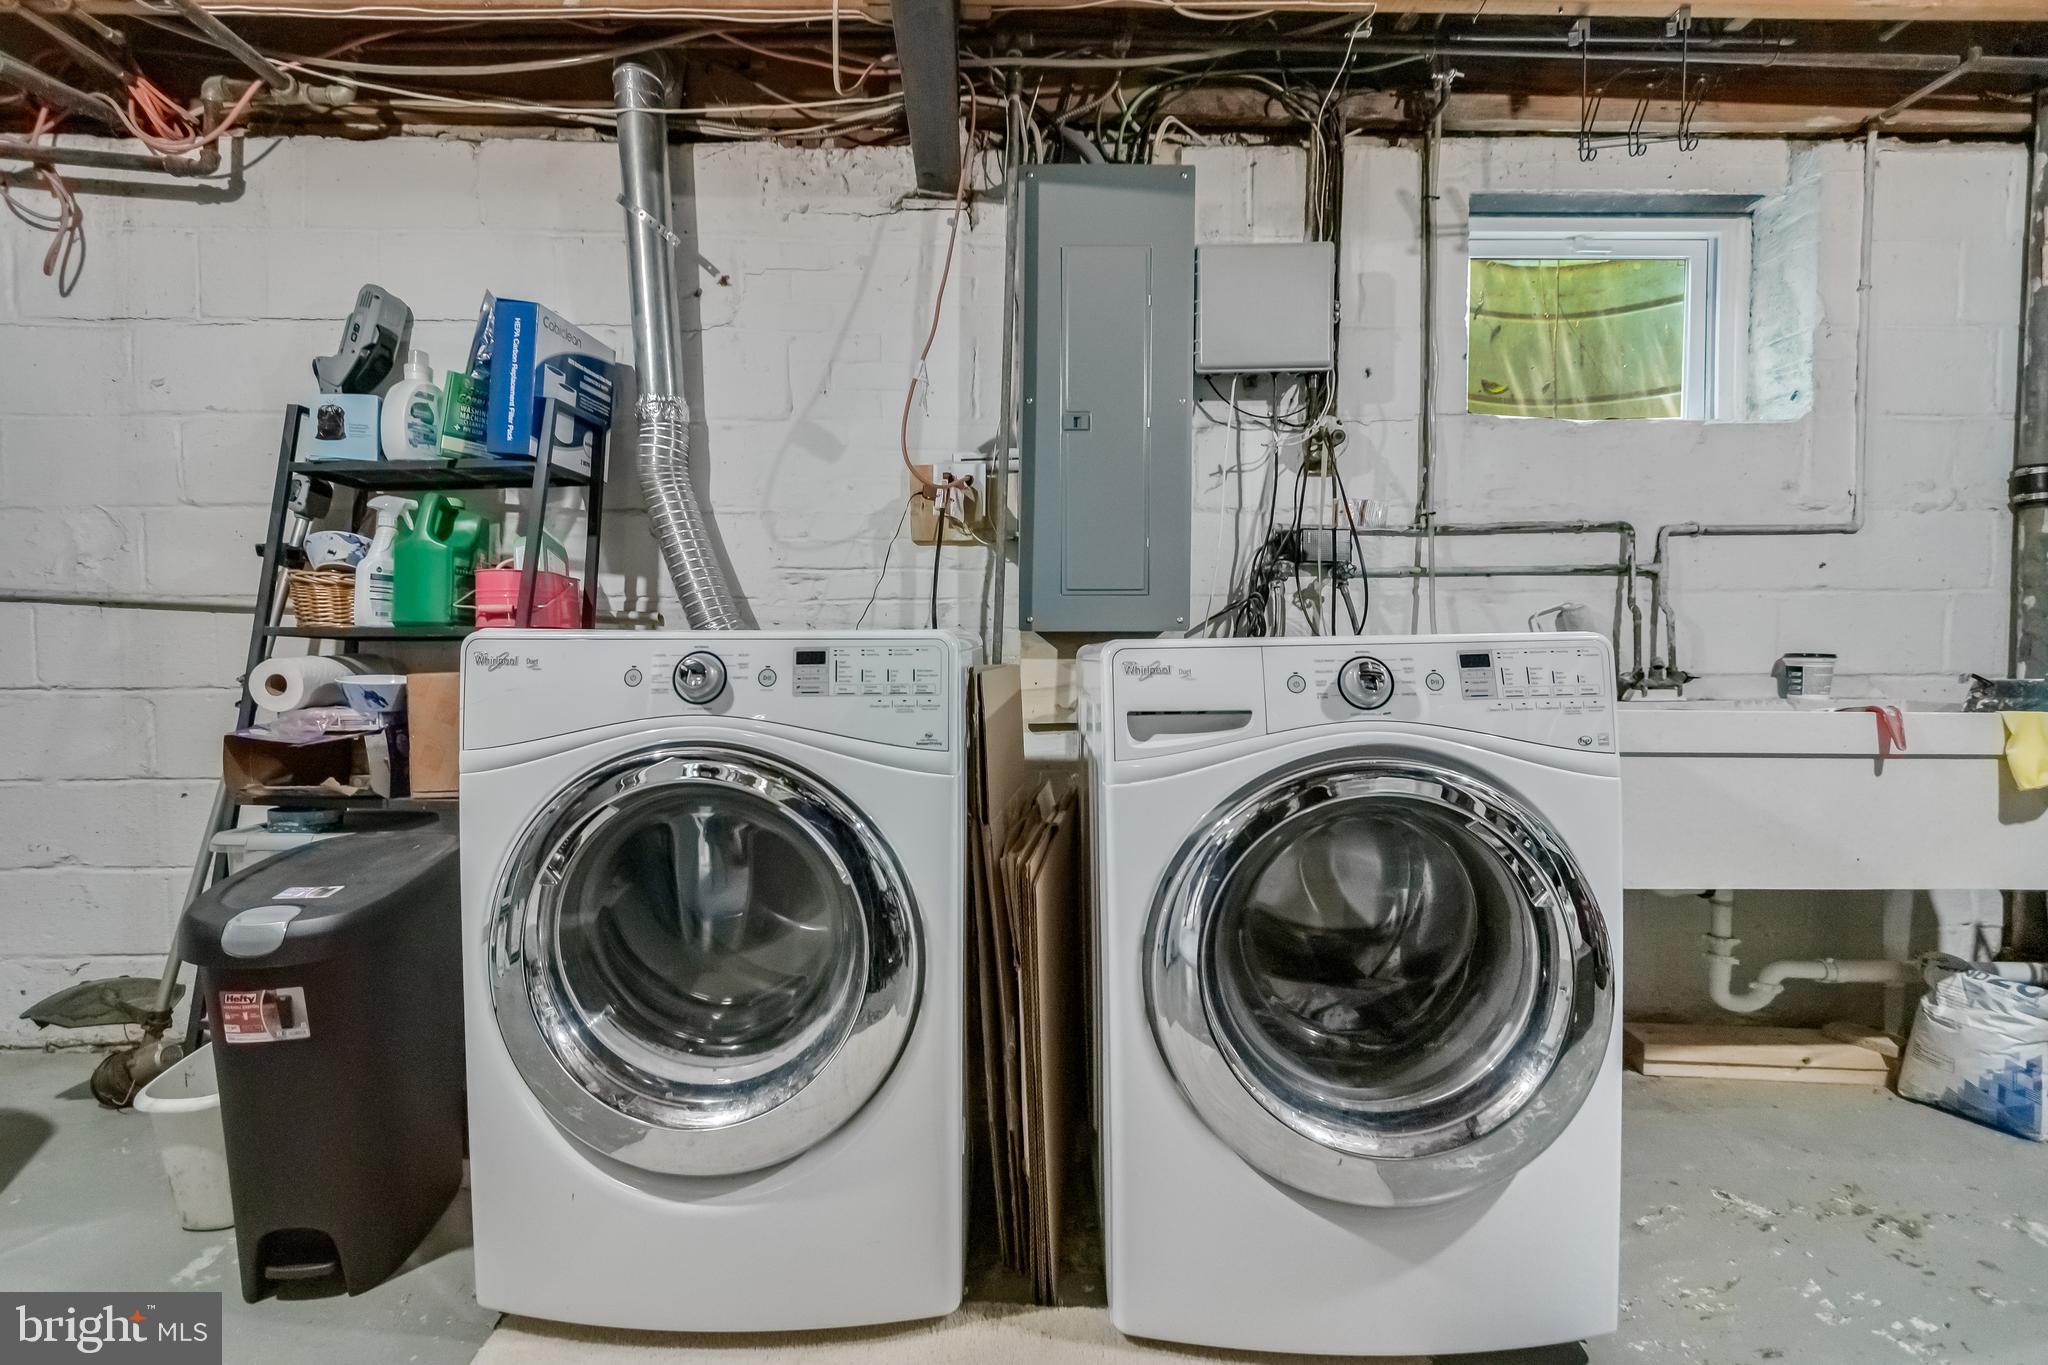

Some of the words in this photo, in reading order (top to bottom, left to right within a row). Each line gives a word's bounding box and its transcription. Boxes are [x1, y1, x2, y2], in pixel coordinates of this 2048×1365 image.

[513, 317, 521, 338] HEPA
[511, 338, 520, 363] Carbon
[509, 363, 518, 407] Replacement
[460, 405, 488, 418] WASHIN
[507, 407, 515, 424] Filter
[474, 653, 520, 671] Whirlpool
[526, 657, 540, 666] Duet
[1123, 661, 1171, 680] Whirlpool
[1178, 667, 1192, 676] Duet
[226, 995, 256, 1003] Hefty
